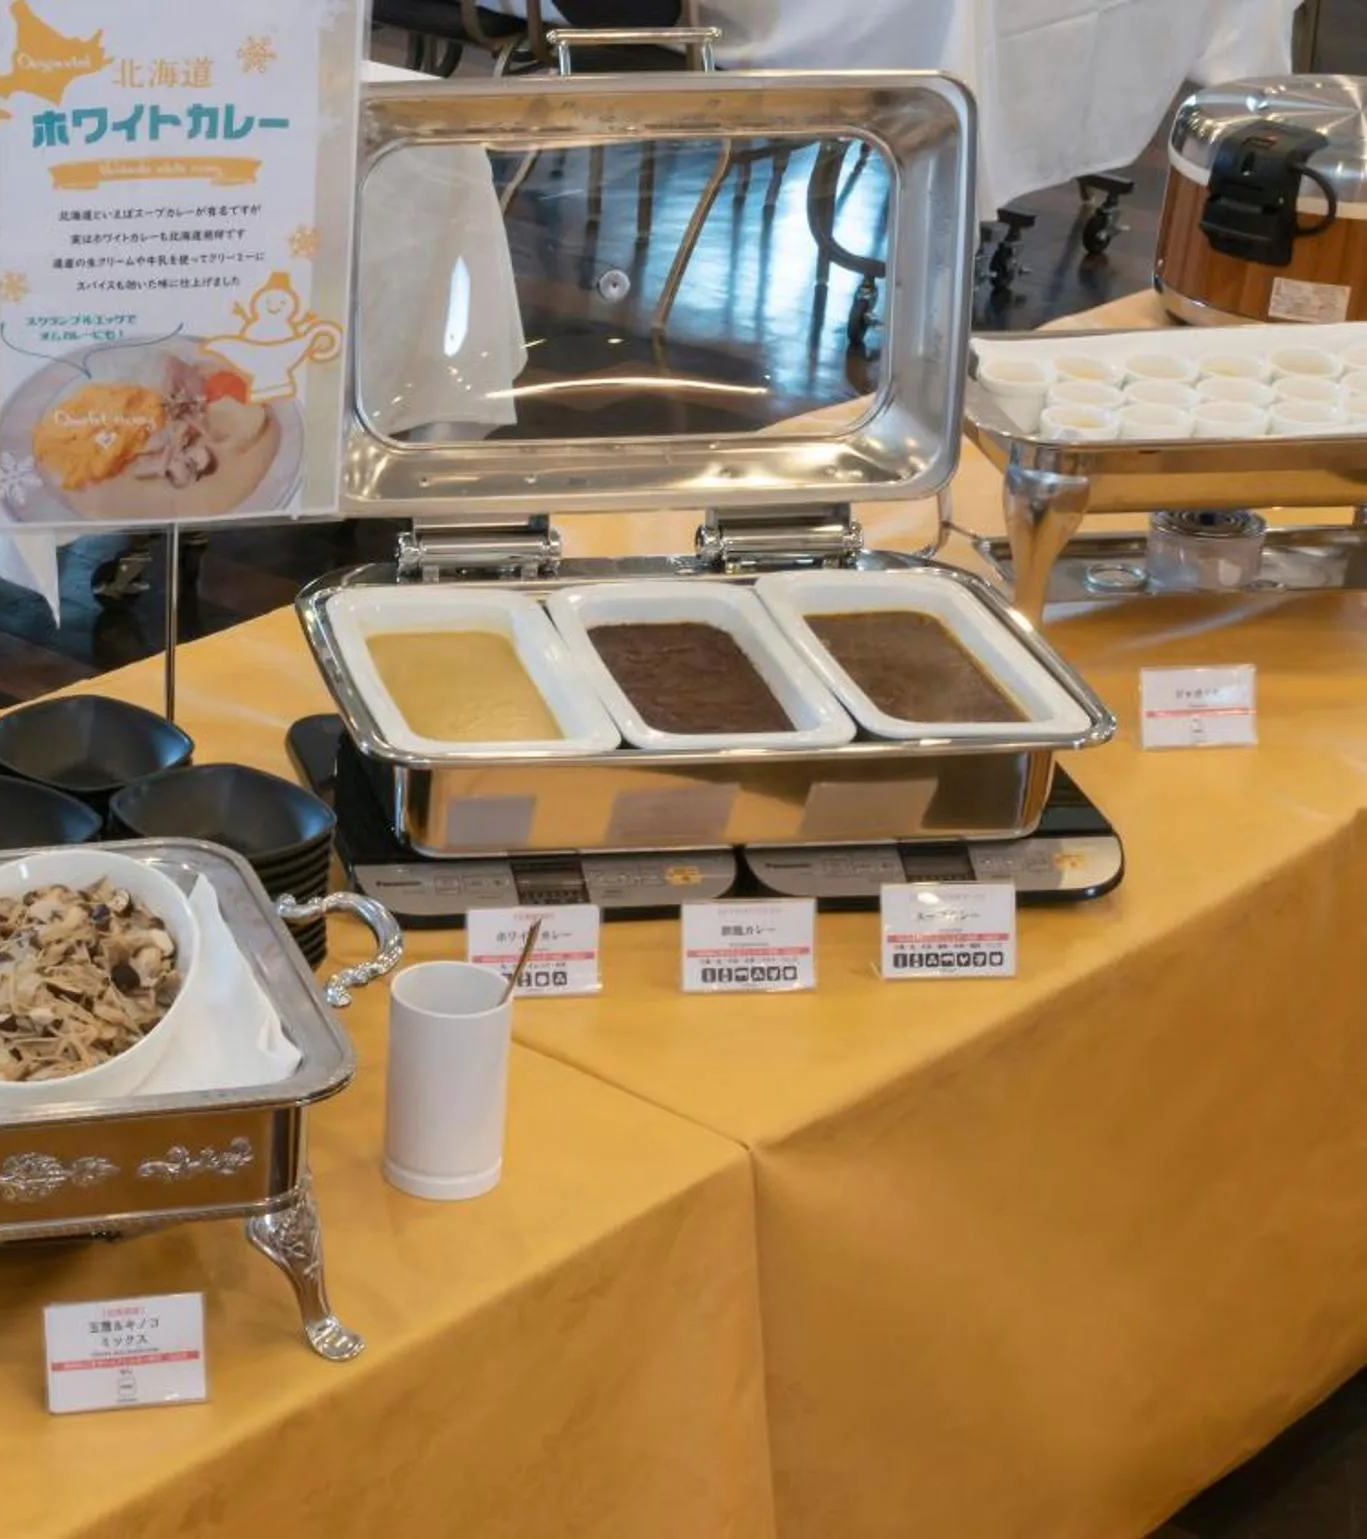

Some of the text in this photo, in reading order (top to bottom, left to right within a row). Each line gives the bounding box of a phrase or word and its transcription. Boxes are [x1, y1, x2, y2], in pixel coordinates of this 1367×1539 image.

[112, 56, 215, 88] 北海道
[32, 103, 290, 148] ホワイトカレー
[496, 930, 573, 943] ホワイカレー
